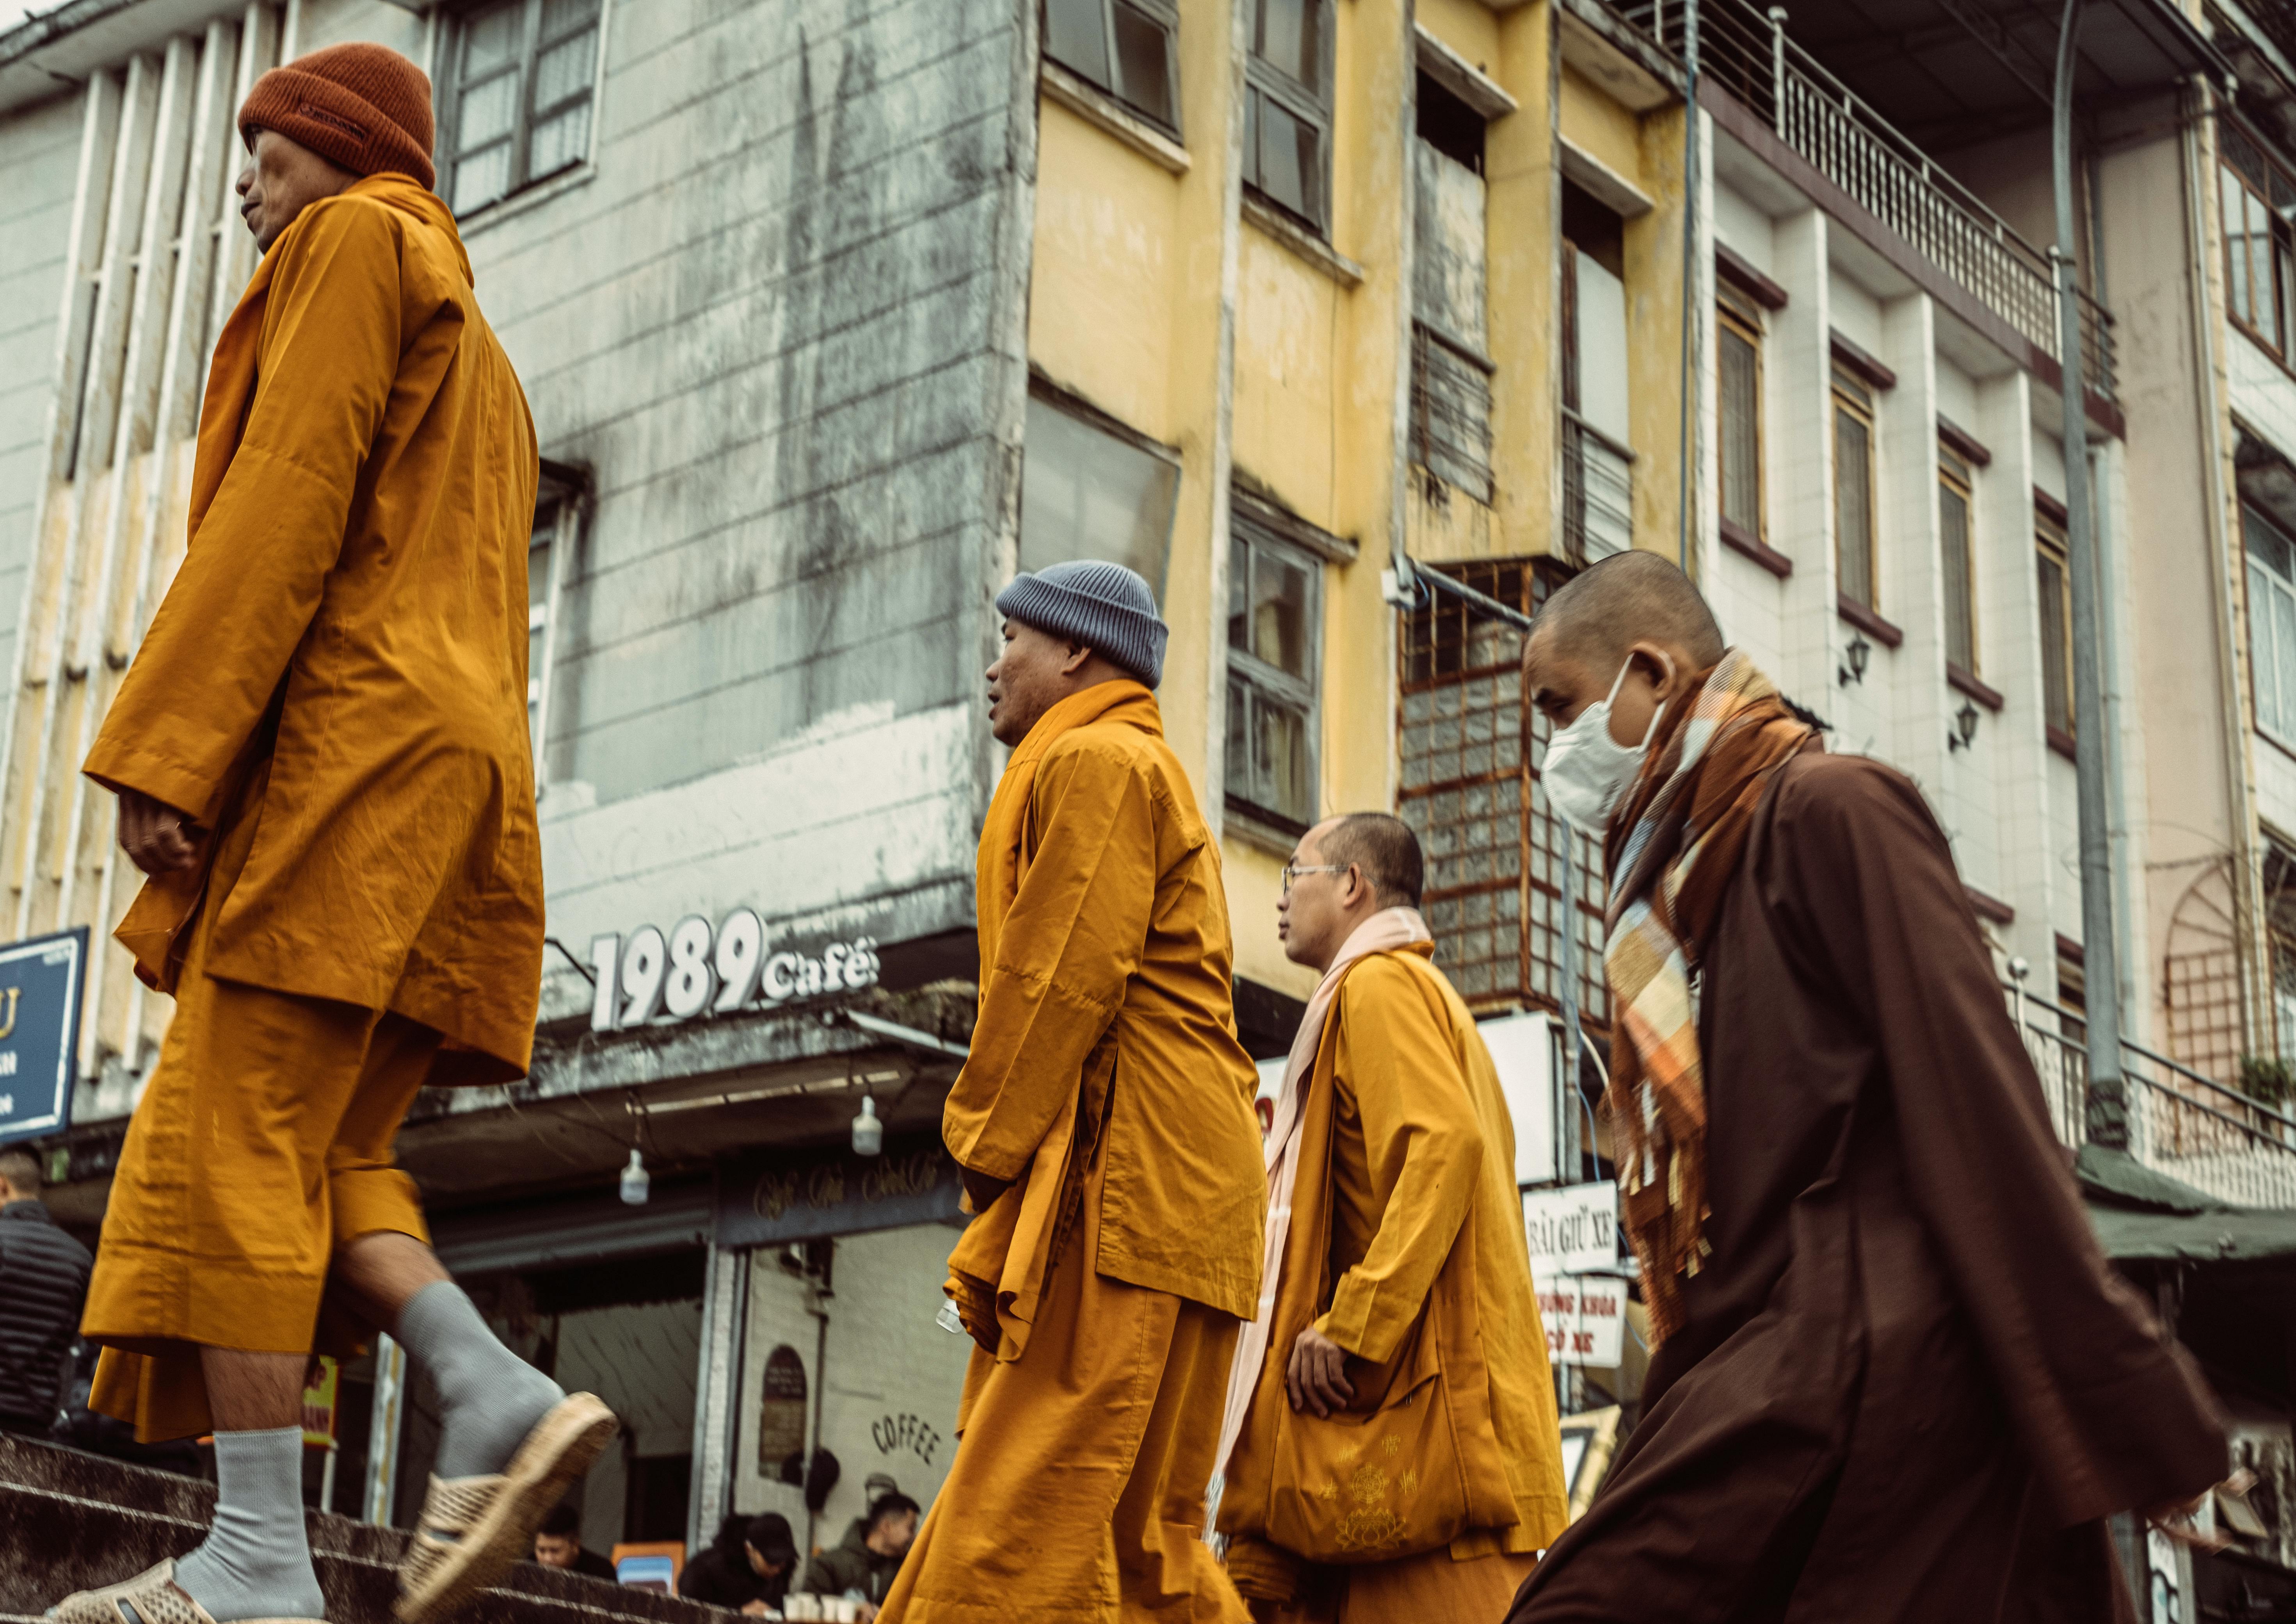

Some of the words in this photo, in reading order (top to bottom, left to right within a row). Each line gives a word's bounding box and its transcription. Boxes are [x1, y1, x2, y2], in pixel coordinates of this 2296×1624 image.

[590, 907, 768, 1033] 1989
[761, 936, 881, 1000] Café
[871, 1413, 941, 1466] COFFEE
